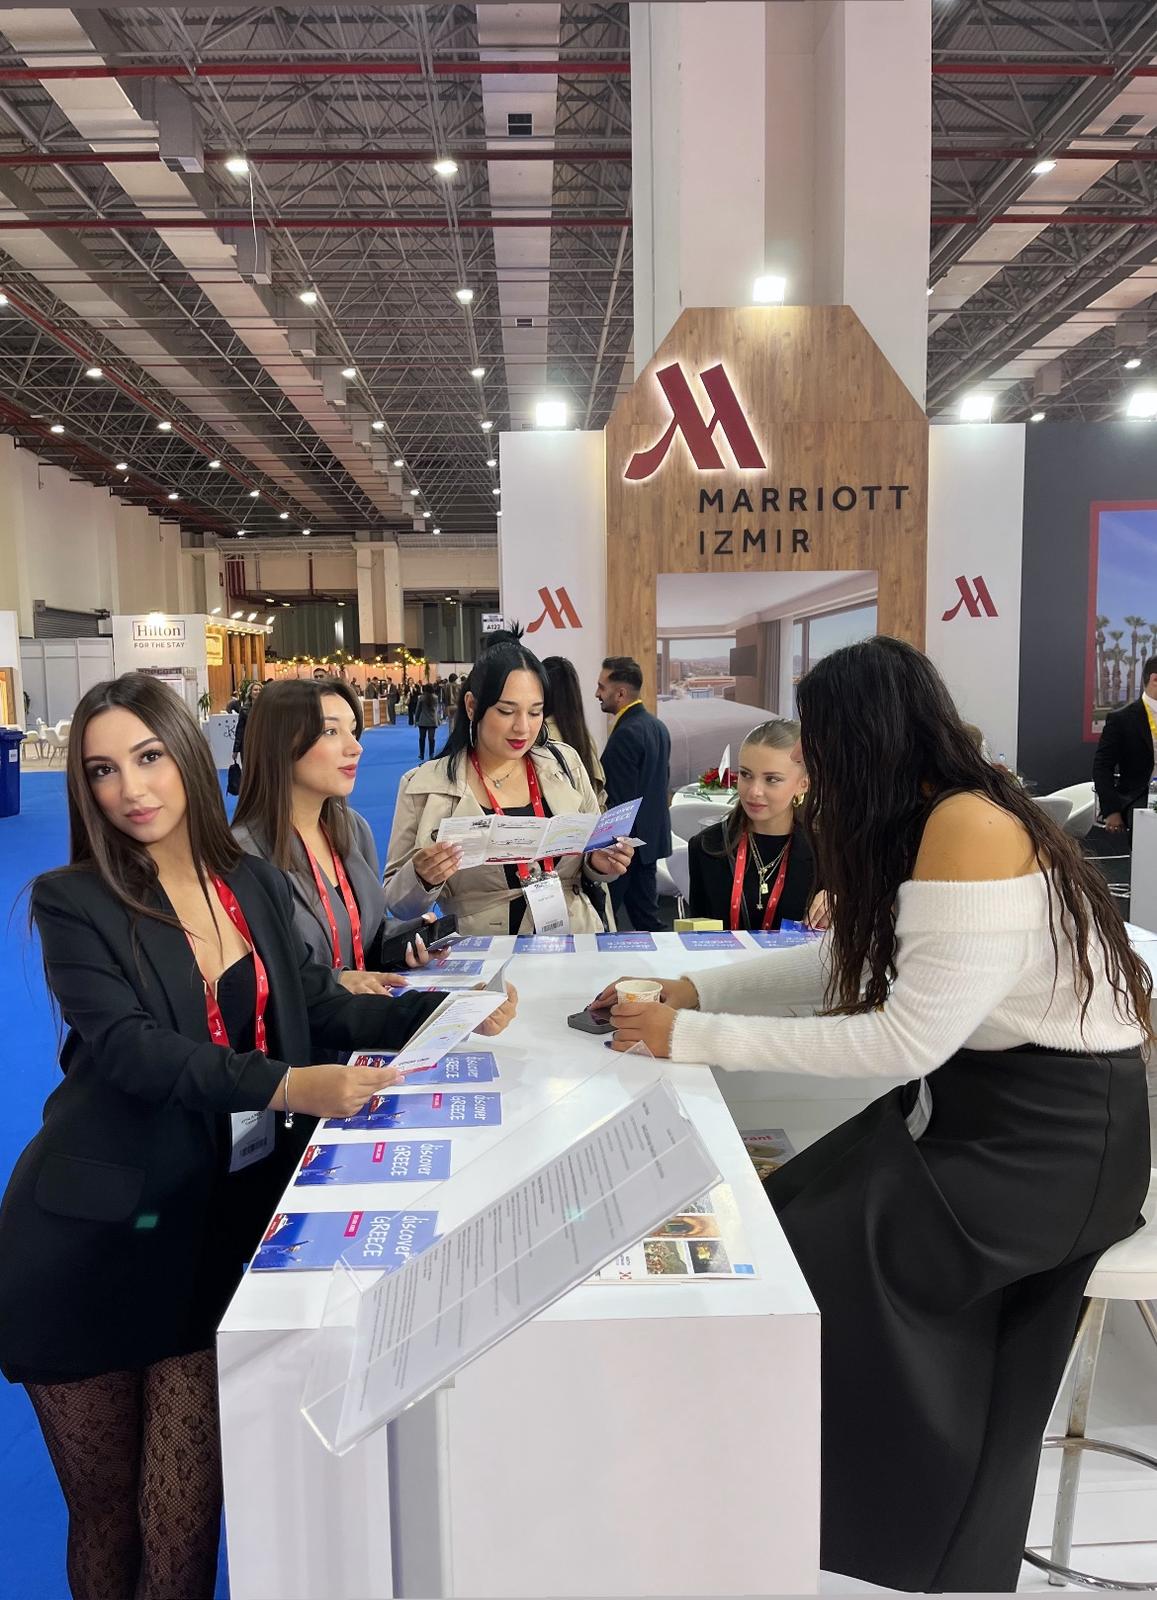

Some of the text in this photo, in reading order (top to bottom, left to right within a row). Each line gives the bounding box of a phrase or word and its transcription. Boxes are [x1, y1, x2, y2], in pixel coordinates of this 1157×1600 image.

[699, 485, 909, 513] MARRIOTT
[699, 528, 810, 555] IZMIR
[137, 624, 181, 637] Hilton
[449, 1095, 466, 1120] GREECE
[473, 1094, 495, 1120] discover
[390, 1144, 412, 1177] GREECE
[418, 1143, 444, 1176] discover
[362, 1215, 392, 1257] GREECE
[394, 1215, 430, 1263] discover
